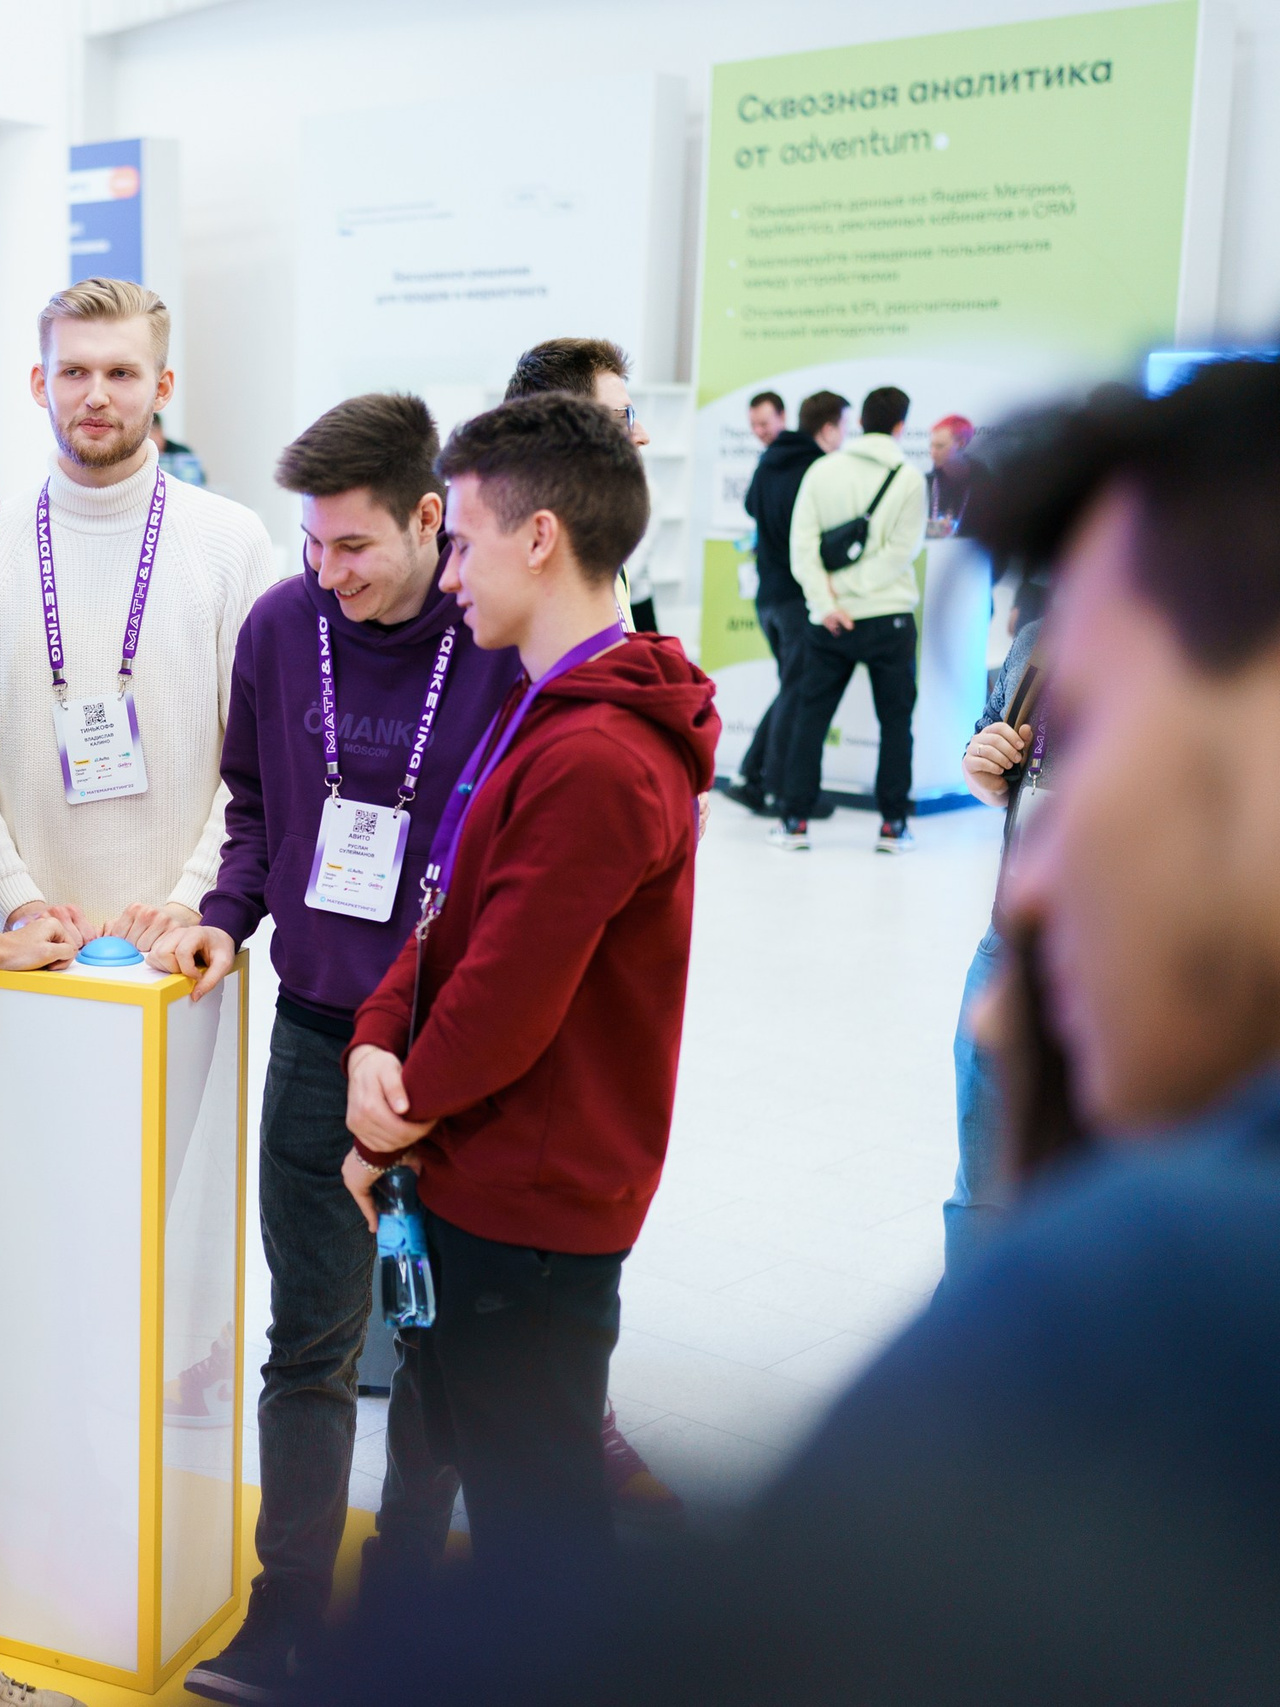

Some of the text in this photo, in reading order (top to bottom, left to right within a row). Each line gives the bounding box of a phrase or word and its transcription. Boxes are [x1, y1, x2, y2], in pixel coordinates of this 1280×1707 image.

[738, 57, 1113, 124] Сквозная аналитика
[735, 143, 771, 170] от
[38, 508, 47, 521] &
[125, 582, 147, 651] MATH
[139, 566, 150, 581] &
[322, 659, 331, 675] &
[322, 677, 337, 753] MATH
[80, 723, 114, 734] ТИНЬКОФФ
[84, 733, 114, 742] ВЛАДИСЛАВ
[343, 743, 390, 758] MOSCOW
[348, 833, 370, 841] АВИТО
[347, 843, 369, 851] РУСЛАН
